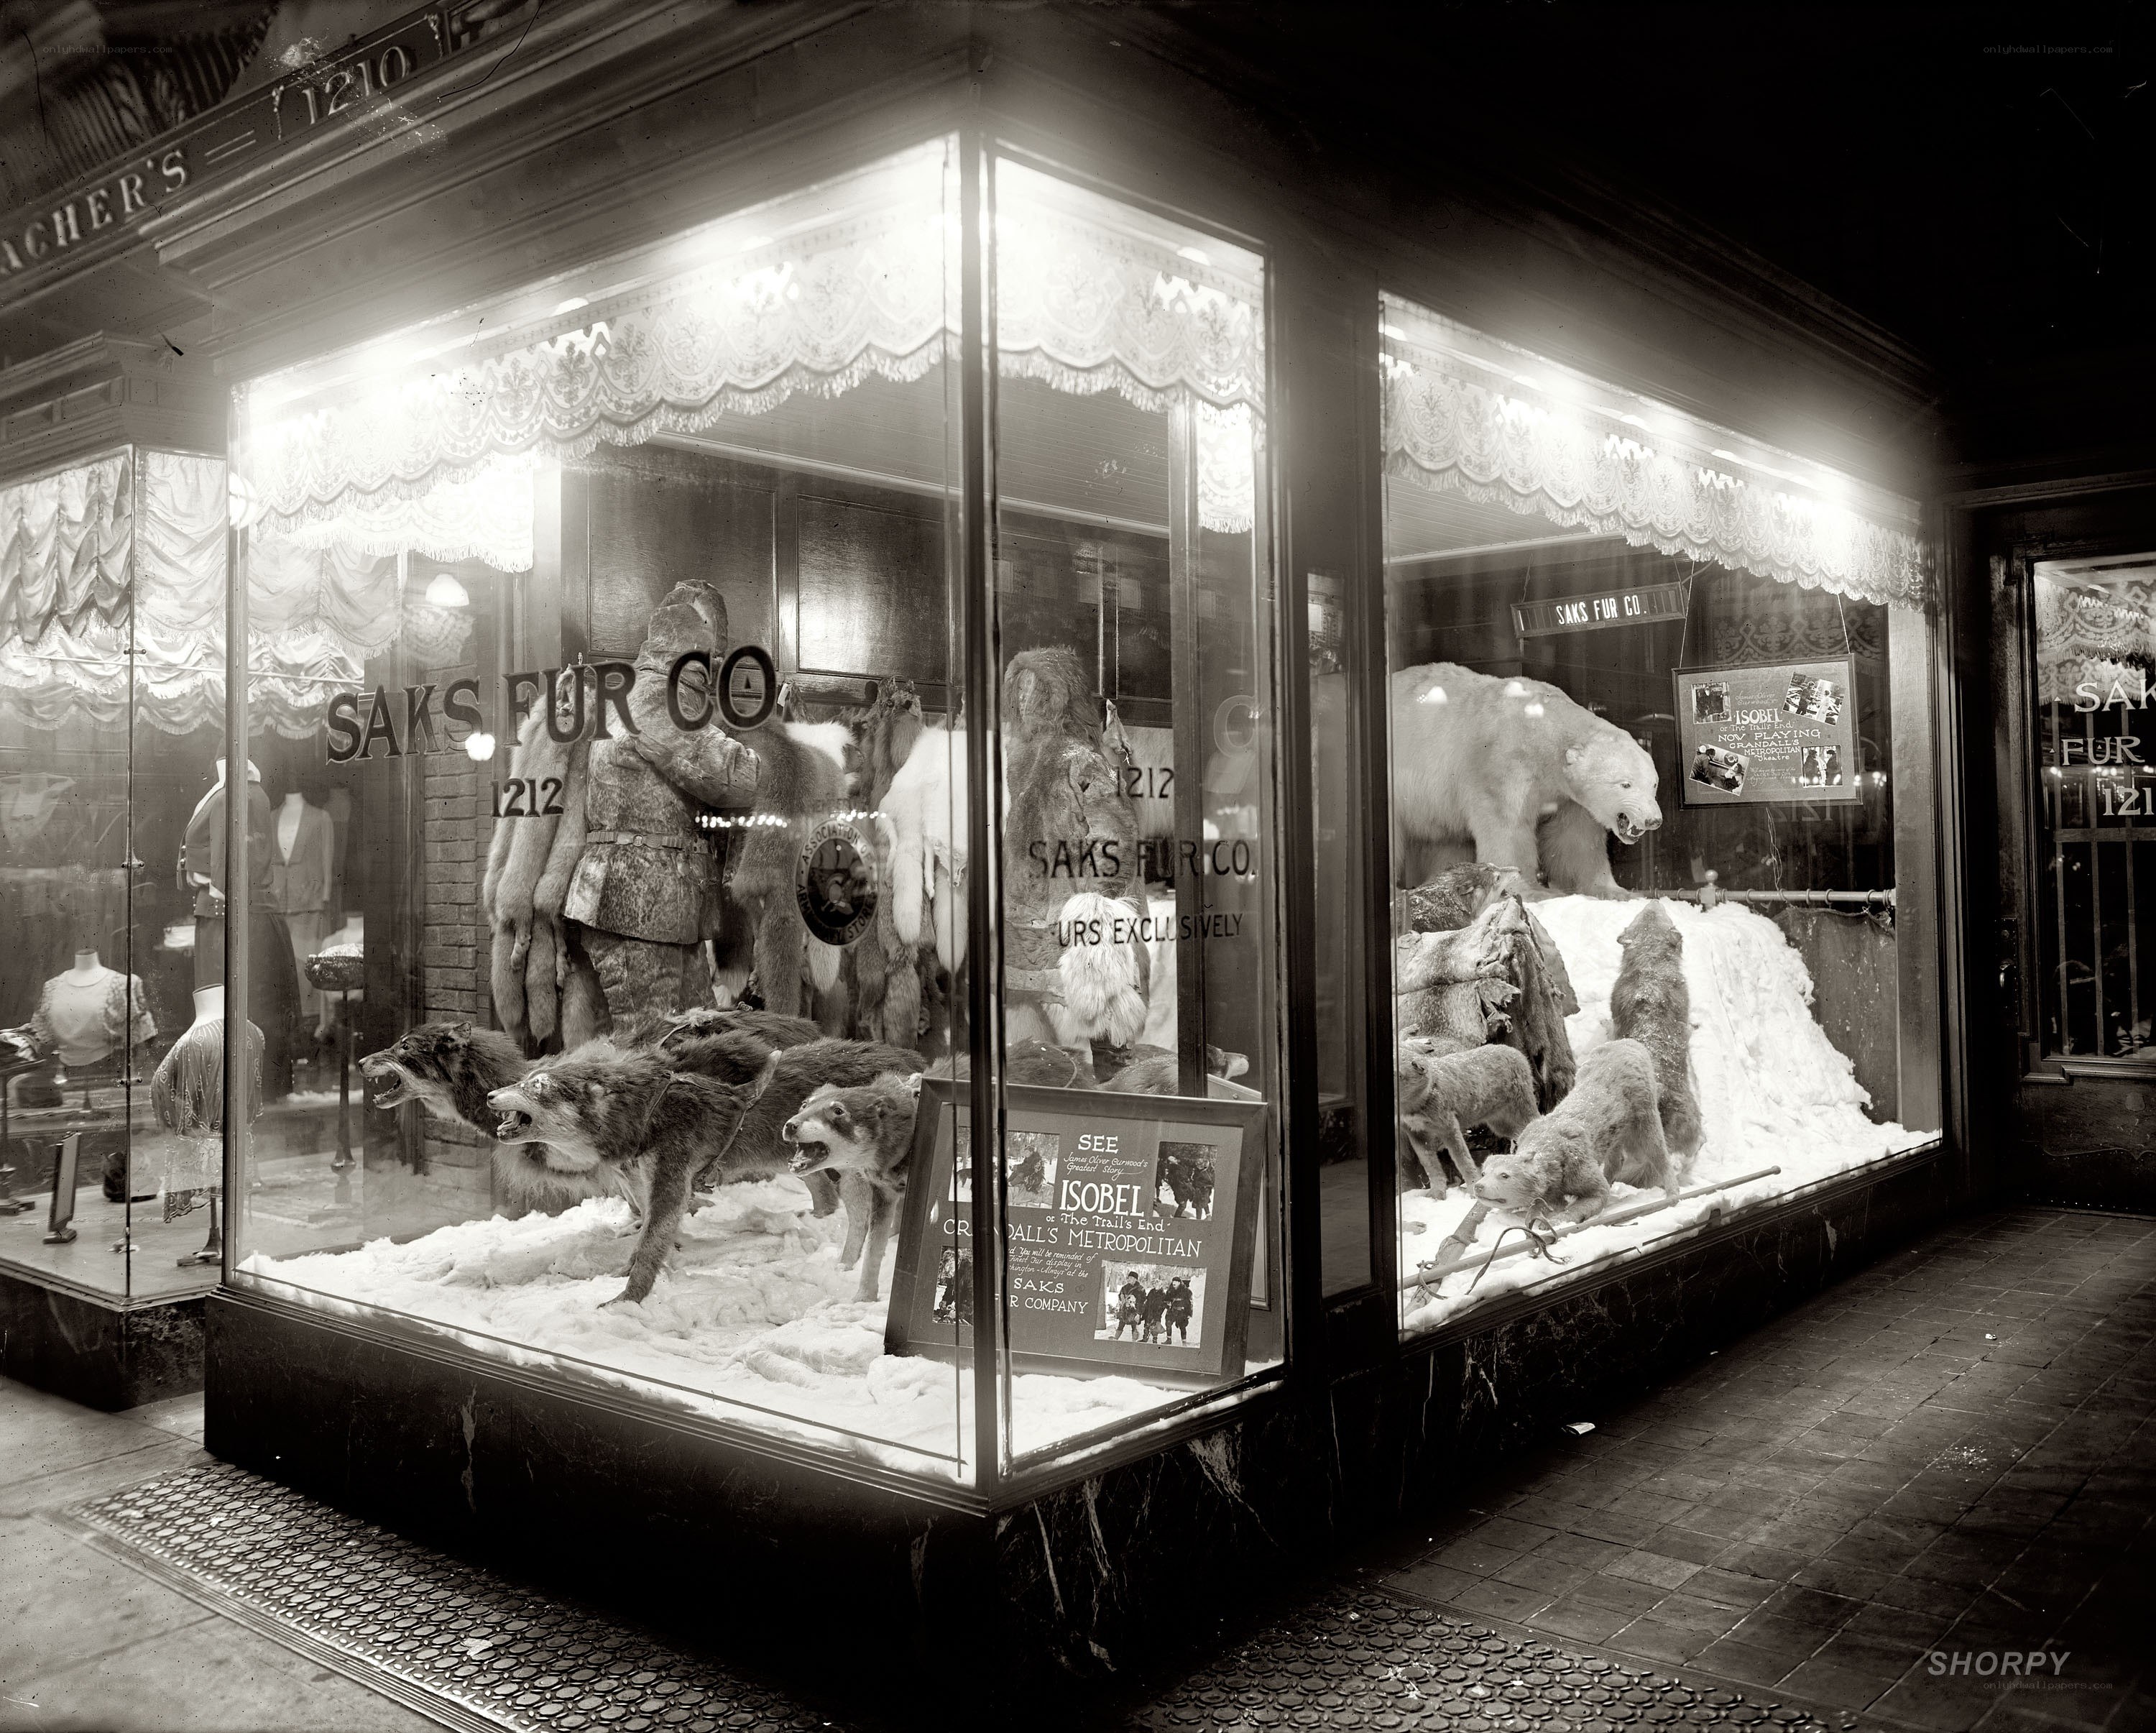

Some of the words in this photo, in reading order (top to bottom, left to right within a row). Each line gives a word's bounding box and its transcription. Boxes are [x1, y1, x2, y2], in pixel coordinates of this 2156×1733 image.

[302, 46, 407, 125] 1210
[1556, 602, 1588, 625] SAKS
[1593, 597, 1618, 620] FUR
[1624, 595, 1646, 616] CO.
[326, 676, 483, 765] SAKS
[502, 661, 641, 748] FUR
[1735, 708, 1782, 725] ISOBEL
[1718, 733, 1746, 742] NOW
[1754, 729, 1821, 740] PLAYING
[1729, 740, 1800, 749] CRANDALL'S
[1744, 746, 1801, 755] METROPOLITAN
[2061, 736, 2145, 766] FUR
[1115, 766, 1174, 798] 1212
[492, 777, 563, 818] 1212
[2103, 788, 2155, 815] 121
[801, 822, 860, 865] ASSOCIATION
[1030, 840, 1120, 878] SAKS
[1136, 841, 1198, 878] FUR
[1052, 919, 1100, 947] URS
[1114, 913, 1243, 944] EXCLUSIVELY
[1078, 1134, 1119, 1154] SEE
[1064, 1151, 1087, 1162] James
[1088, 1155, 1110, 1164] Oliver
[1111, 1157, 1148, 1167] Curwood's
[1067, 1162, 1098, 1175] Greatest
[1102, 1165, 1131, 1181] Story
[1059, 1179, 1144, 1217] ISOBEL
[1092, 1215, 1133, 1229] Trail's
[1068, 1228, 1202, 1258] METROPOLITAN
[1018, 1246, 1031, 1257] You
[1031, 1247, 1045, 1256] will
[1053, 1251, 1084, 1261] reminded
[1086, 1252, 1098, 1264] of
[1046, 1258, 1073, 1271] display
[1041, 1266, 1065, 1279] Always
[1078, 1269, 1089, 1278] the
[1014, 1278, 1064, 1294] SAKS
[1025, 1297, 1089, 1314] COMPANY
